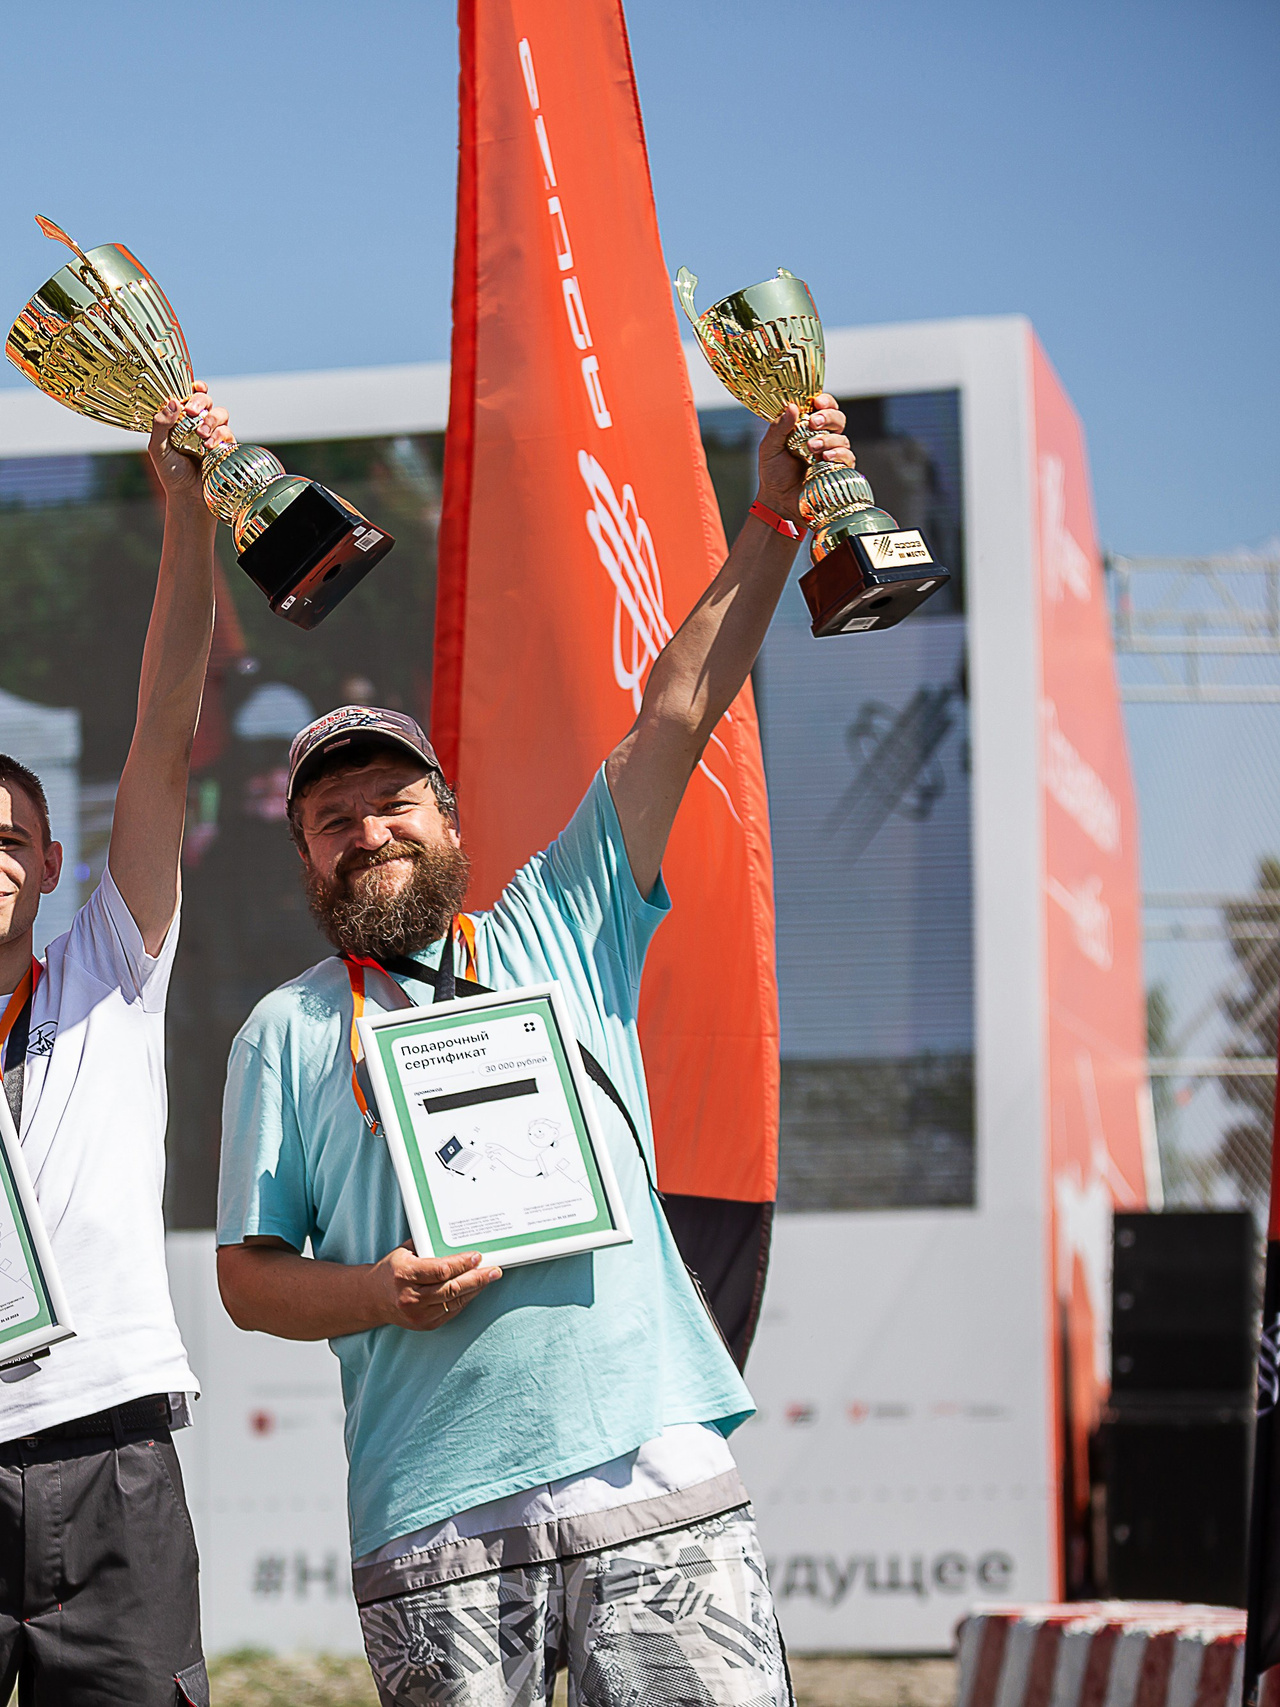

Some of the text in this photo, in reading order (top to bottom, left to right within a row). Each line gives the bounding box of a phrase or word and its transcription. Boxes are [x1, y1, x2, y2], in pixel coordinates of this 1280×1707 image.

[401, 1031, 489, 1056] Подарочный
[404, 1048, 487, 1071] сертификат
[485, 1055, 548, 1073] 30 000 рублей
[414, 1086, 443, 1096] промокод
